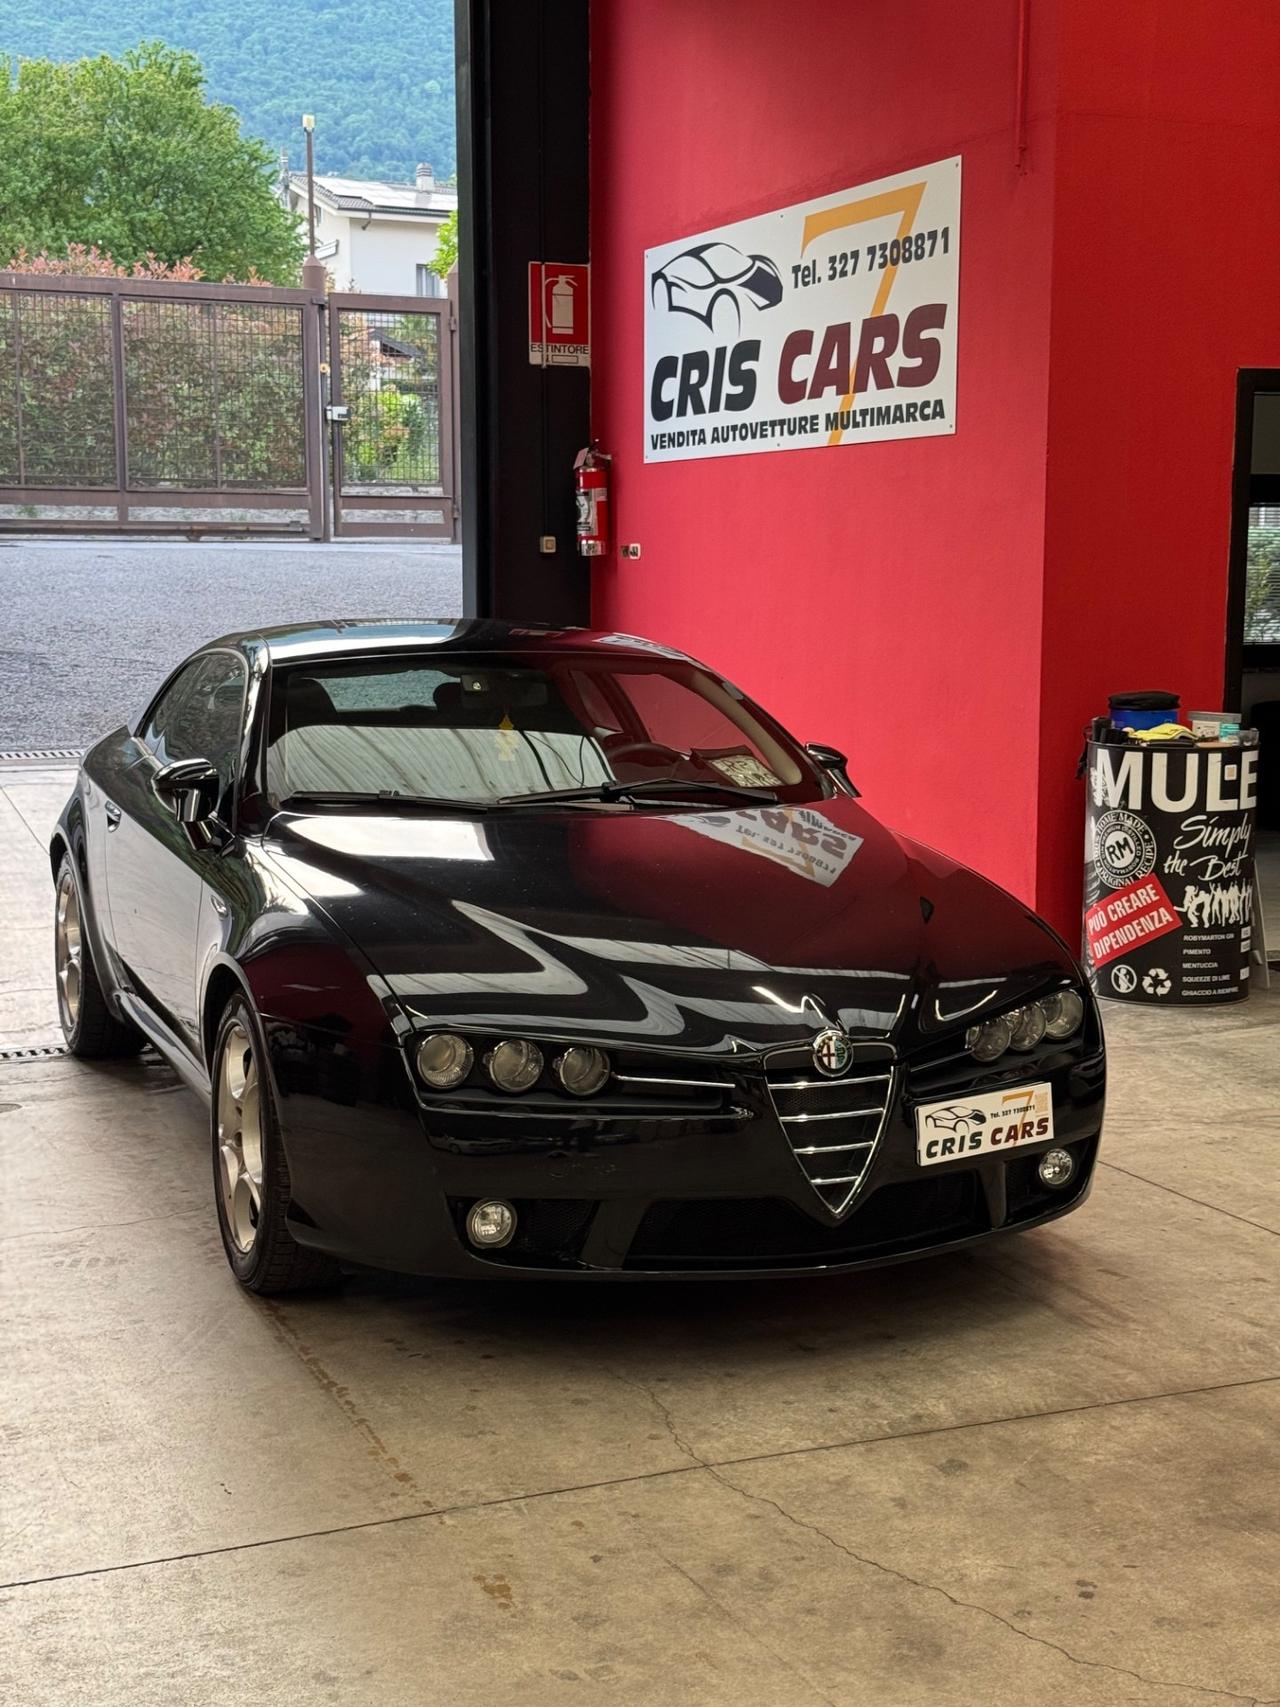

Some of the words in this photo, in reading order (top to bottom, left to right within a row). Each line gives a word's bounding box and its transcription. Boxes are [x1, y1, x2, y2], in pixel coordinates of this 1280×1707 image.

[792, 264, 821, 289] Tel.
[828, 249, 860, 281] 327
[867, 226, 949, 271] 7308871
[530, 343, 589, 355] ESTINTORE
[650, 340, 761, 421] CRIS
[777, 303, 947, 404] CARS
[651, 428, 706, 450] VENDITA
[711, 415, 819, 443] AUTOVETTURE
[825, 399, 945, 432] MULTIMARCA
[1096, 749, 1259, 812] MULE
[1119, 813, 1144, 834] MADE
[1173, 812, 1251, 858] Simply
[1105, 836, 1133, 864] RM
[1163, 850, 1188, 876] the
[1189, 850, 1249, 881] Best
[1088, 908, 1107, 935] PUÒ
[1107, 884, 1160, 921] CREARE
[1093, 907, 1173, 959] DIPENDENZA
[926, 1131, 983, 1159] CRIS
[990, 1117, 1049, 1147] CARS
